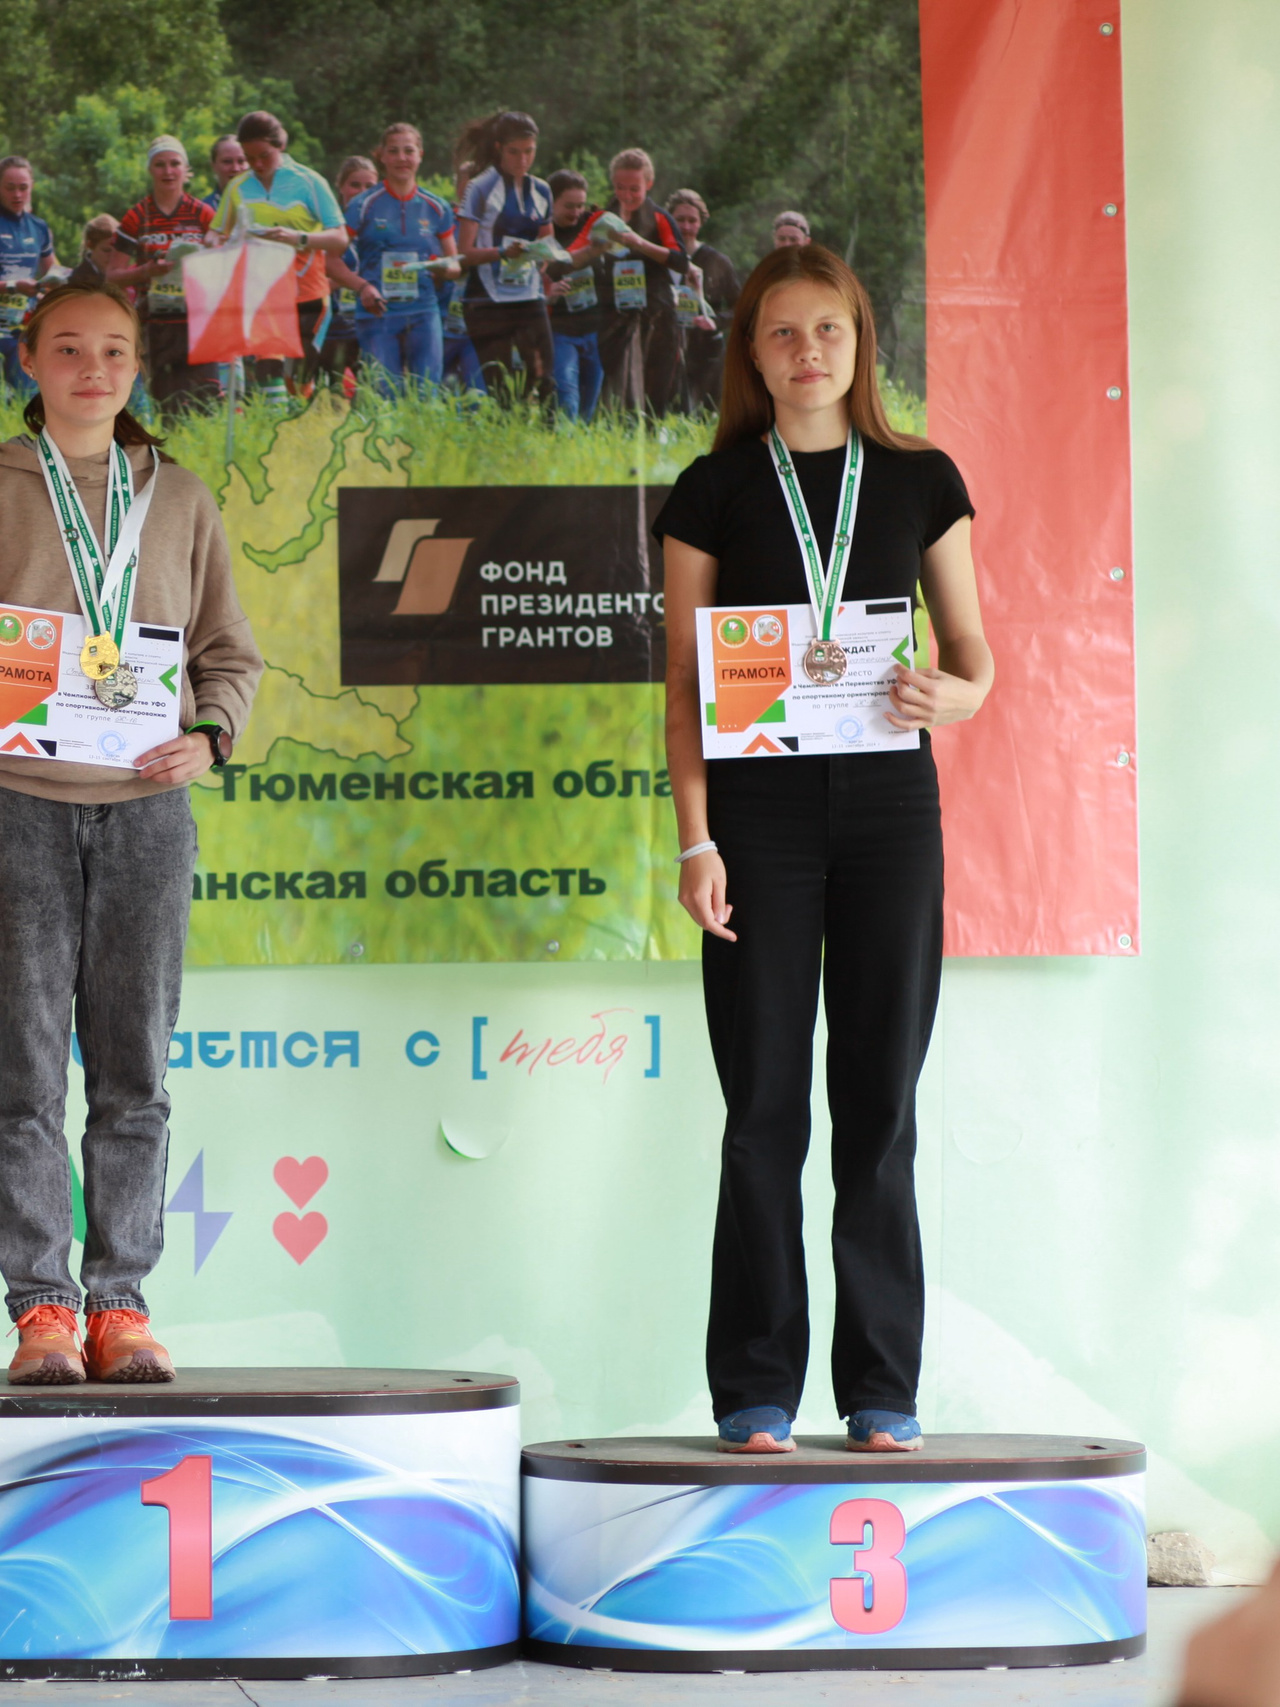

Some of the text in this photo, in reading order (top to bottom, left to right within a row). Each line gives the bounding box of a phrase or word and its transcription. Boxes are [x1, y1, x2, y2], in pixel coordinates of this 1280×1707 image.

[72, 545, 91, 602] КУРГАНСКАЯ ОБЛАСТЬ
[479, 561, 567, 585] ФОНД
[809, 547, 819, 580] КУРГАНСКАЯ
[828, 550, 843, 607] КУРГАНСКАЯ ОБЛАСТЬ
[118, 596, 127, 629] КУРГАНСКАЯ
[482, 626, 613, 648] ГРАНТОВ
[721, 666, 786, 681] ГРАМОТА
[63, 692, 97, 700] Чемпиона
[65, 703, 109, 712] спортивному
[110, 708, 167, 718] ориентированию
[825, 702, 849, 710] группе
[87, 714, 111, 722] группе
[218, 763, 534, 802] Тюменская
[194, 859, 607, 900] нская область
[141, 1454, 214, 1621] 1
[828, 1497, 908, 1635] 3
